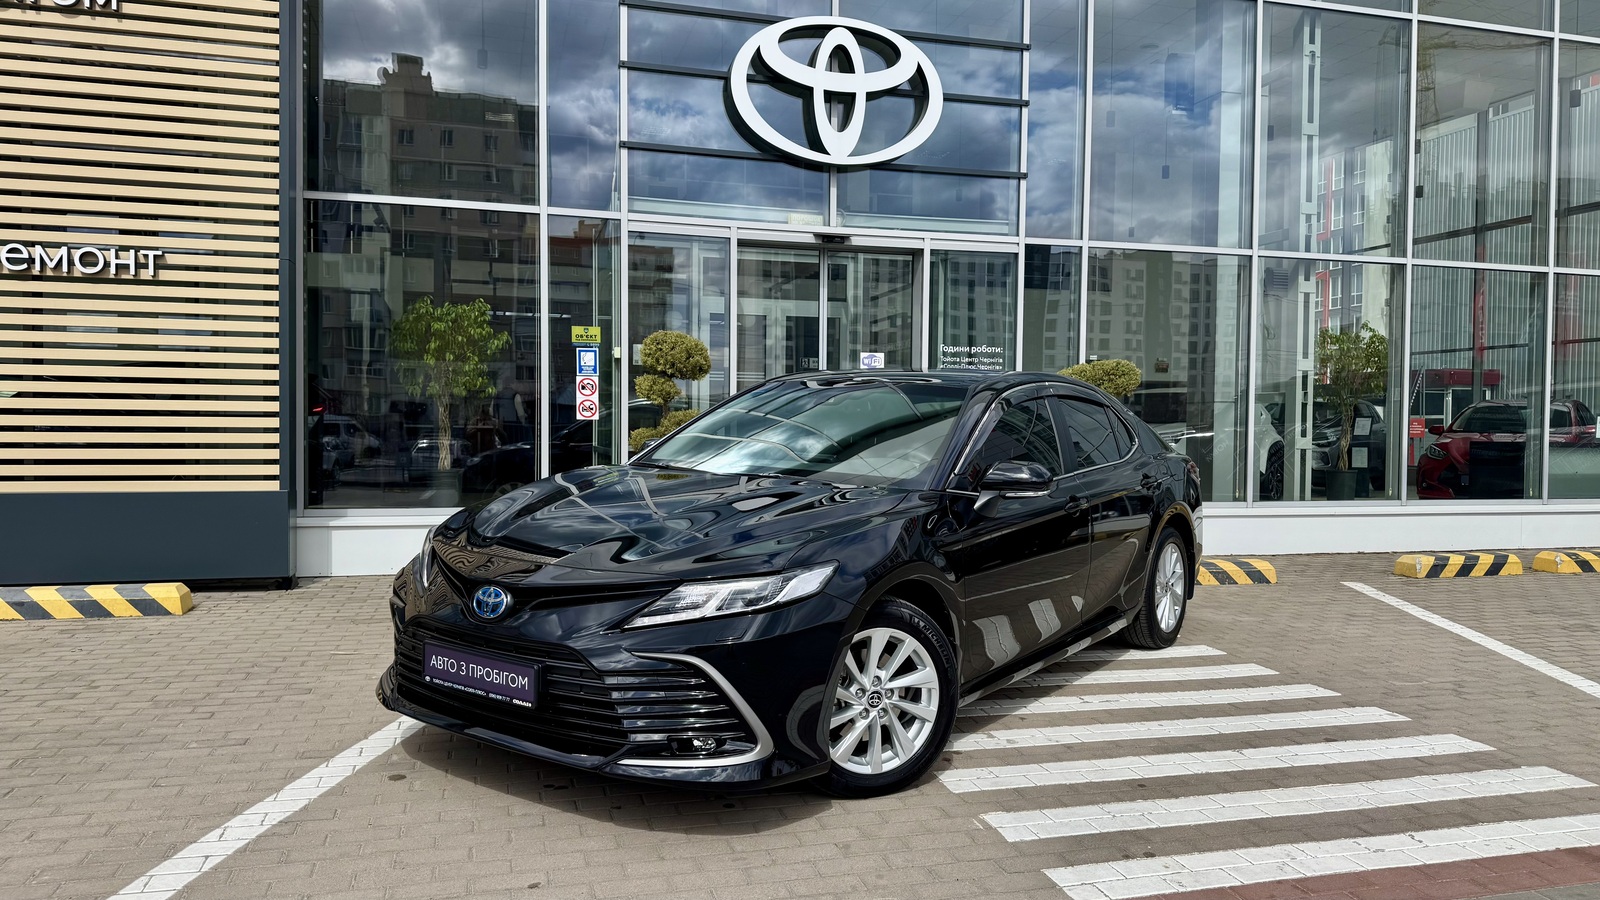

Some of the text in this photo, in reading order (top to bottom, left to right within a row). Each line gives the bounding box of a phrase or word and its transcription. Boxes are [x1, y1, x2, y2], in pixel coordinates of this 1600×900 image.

[940, 344, 1004, 355] Години роботи:
[430, 655, 457, 672] АВТО
[459, 661, 467, 675] З
[469, 664, 528, 690] ПРОБІГОМ
